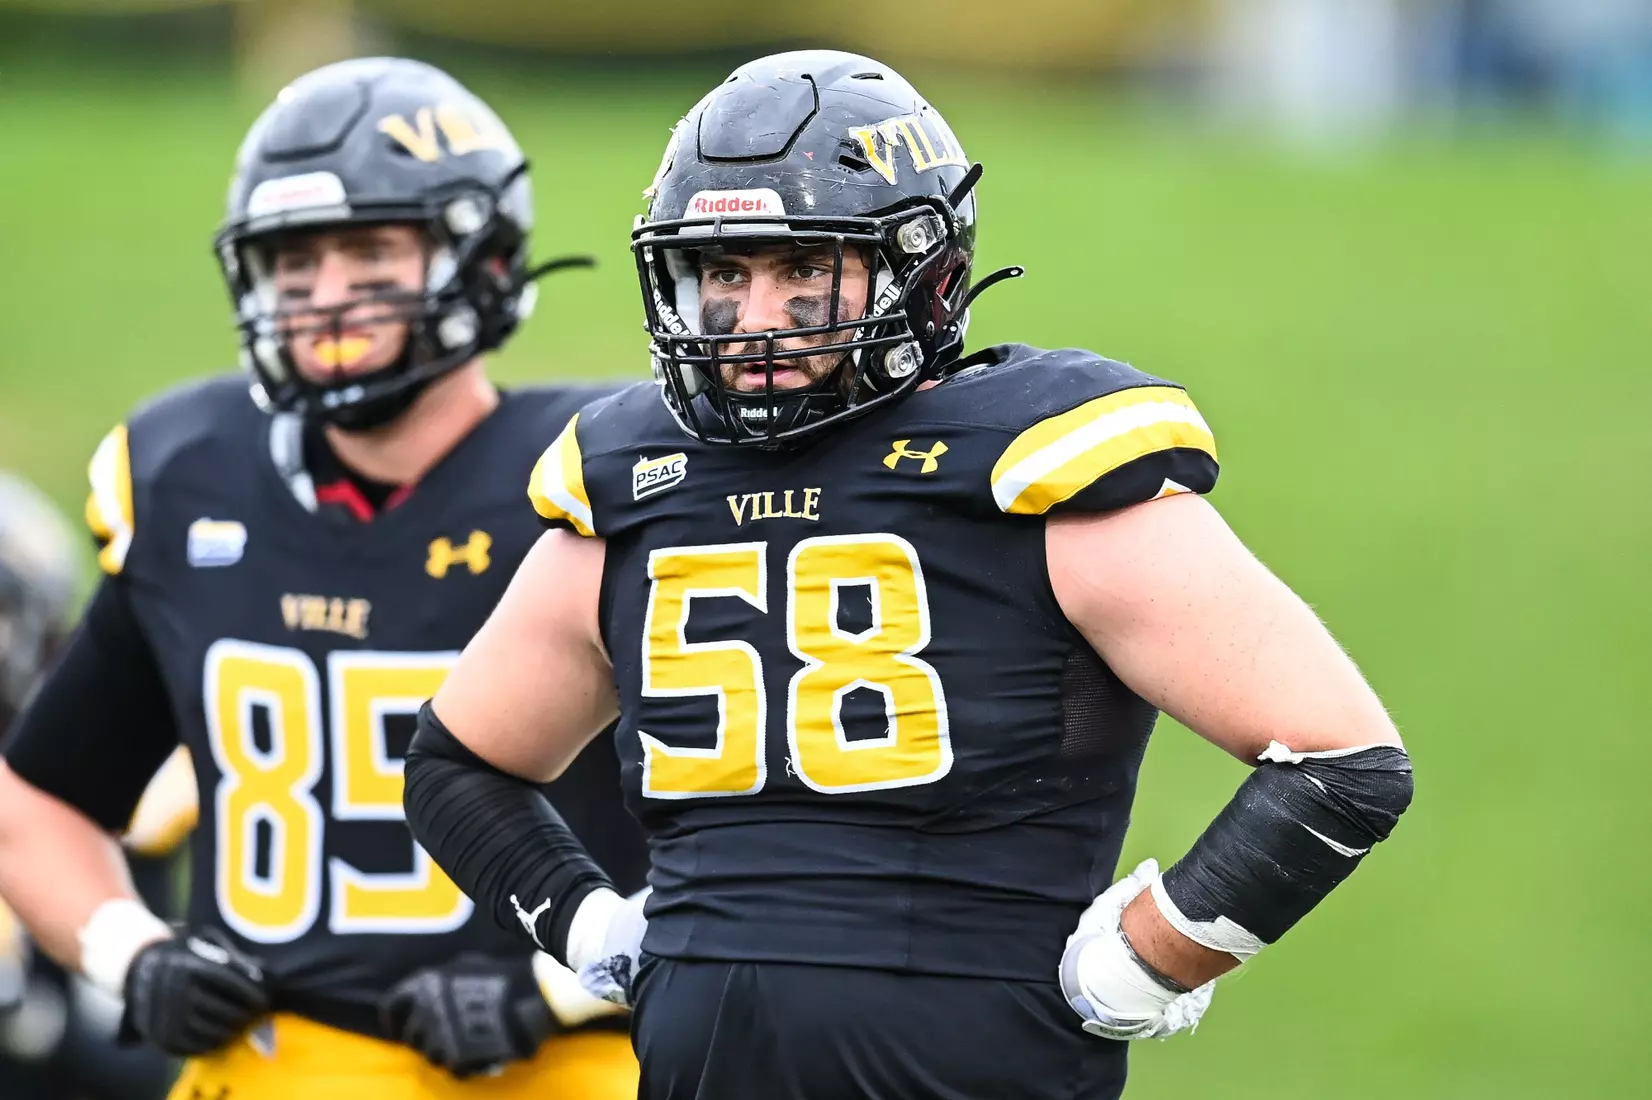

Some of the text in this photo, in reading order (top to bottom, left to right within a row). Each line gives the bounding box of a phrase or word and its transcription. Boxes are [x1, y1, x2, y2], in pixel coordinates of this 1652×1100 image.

[636, 460, 682, 488] PSAC
[727, 487, 822, 526] VILLE
[638, 533, 954, 799] 58
[204, 638, 476, 944] 85
